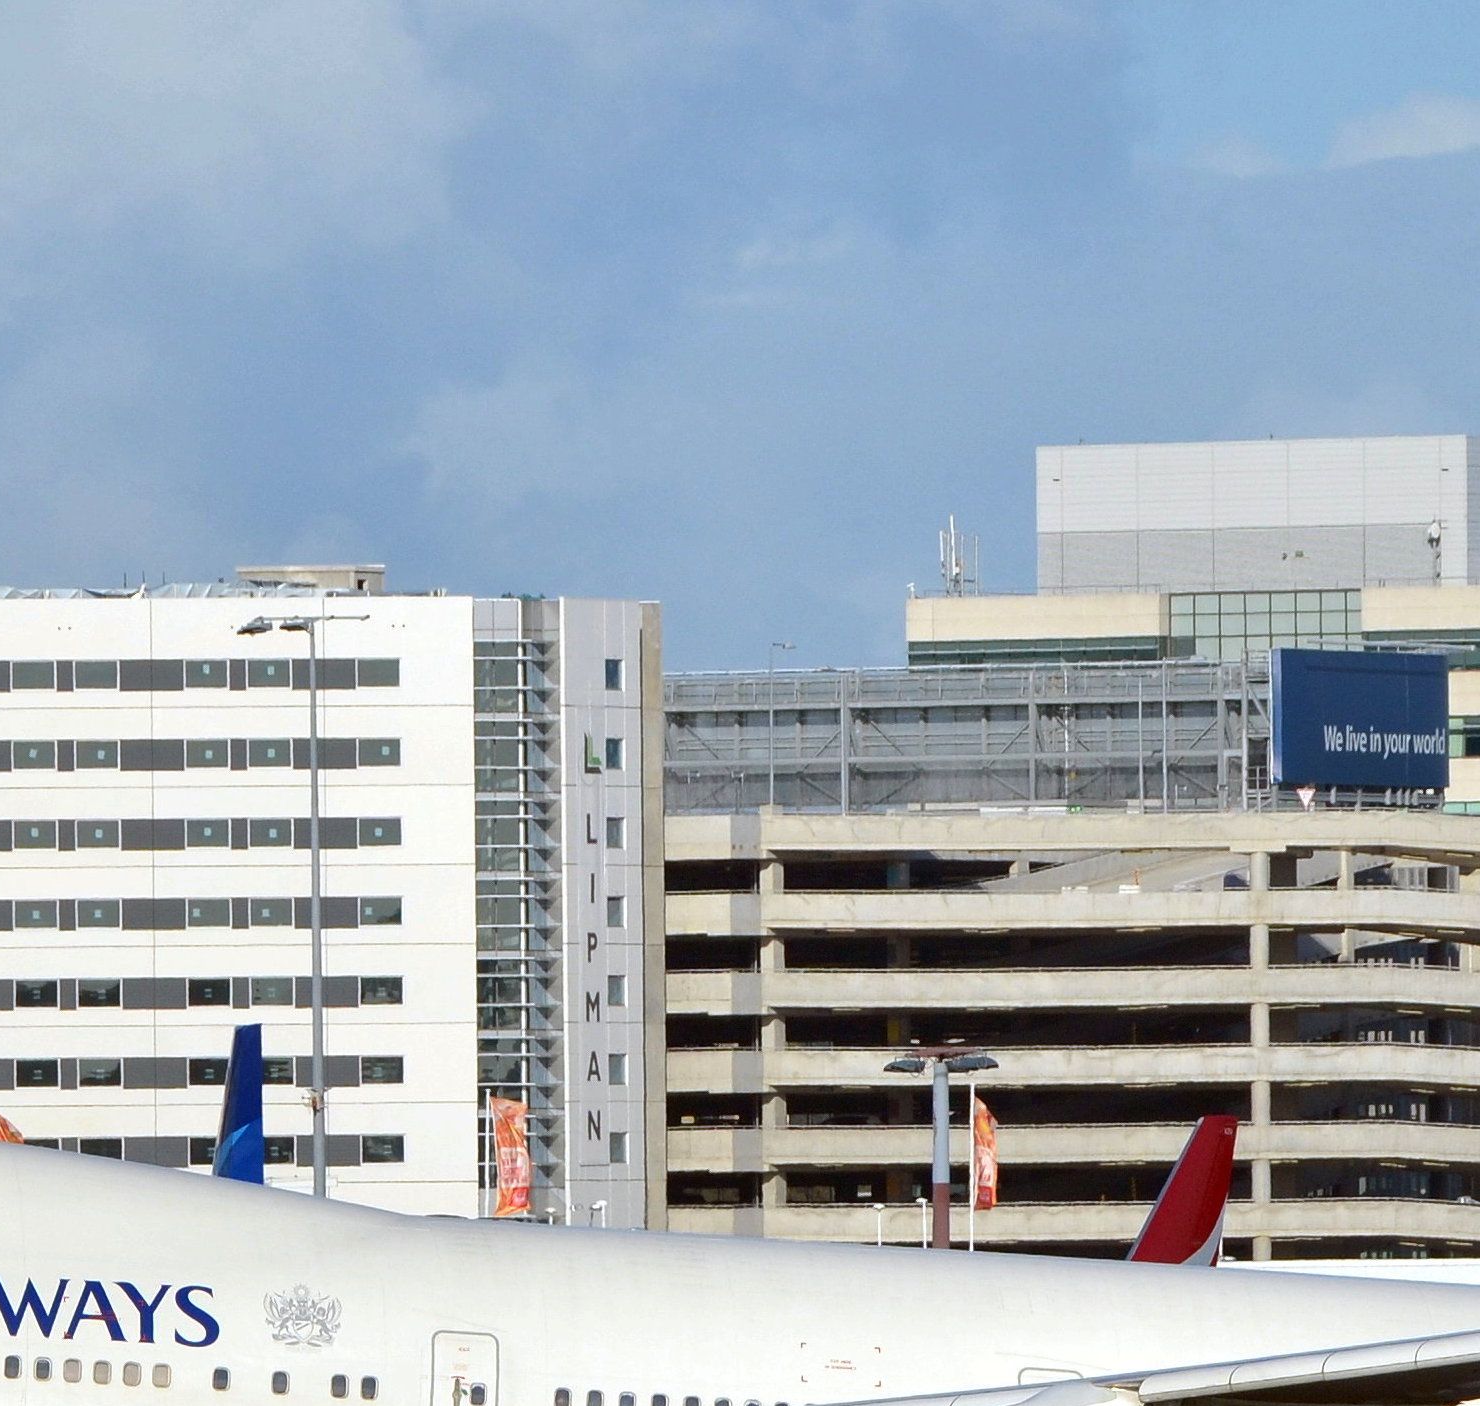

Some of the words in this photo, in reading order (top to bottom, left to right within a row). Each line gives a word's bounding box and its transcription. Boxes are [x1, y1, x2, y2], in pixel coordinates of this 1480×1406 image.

[1323, 724, 1344, 752] We
[1345, 723, 1367, 752] live
[1370, 725, 1381, 753] in
[1383, 733, 1410, 760] your
[1413, 727, 1446, 755] world
[585, 813, 603, 1142] LIPMAN
